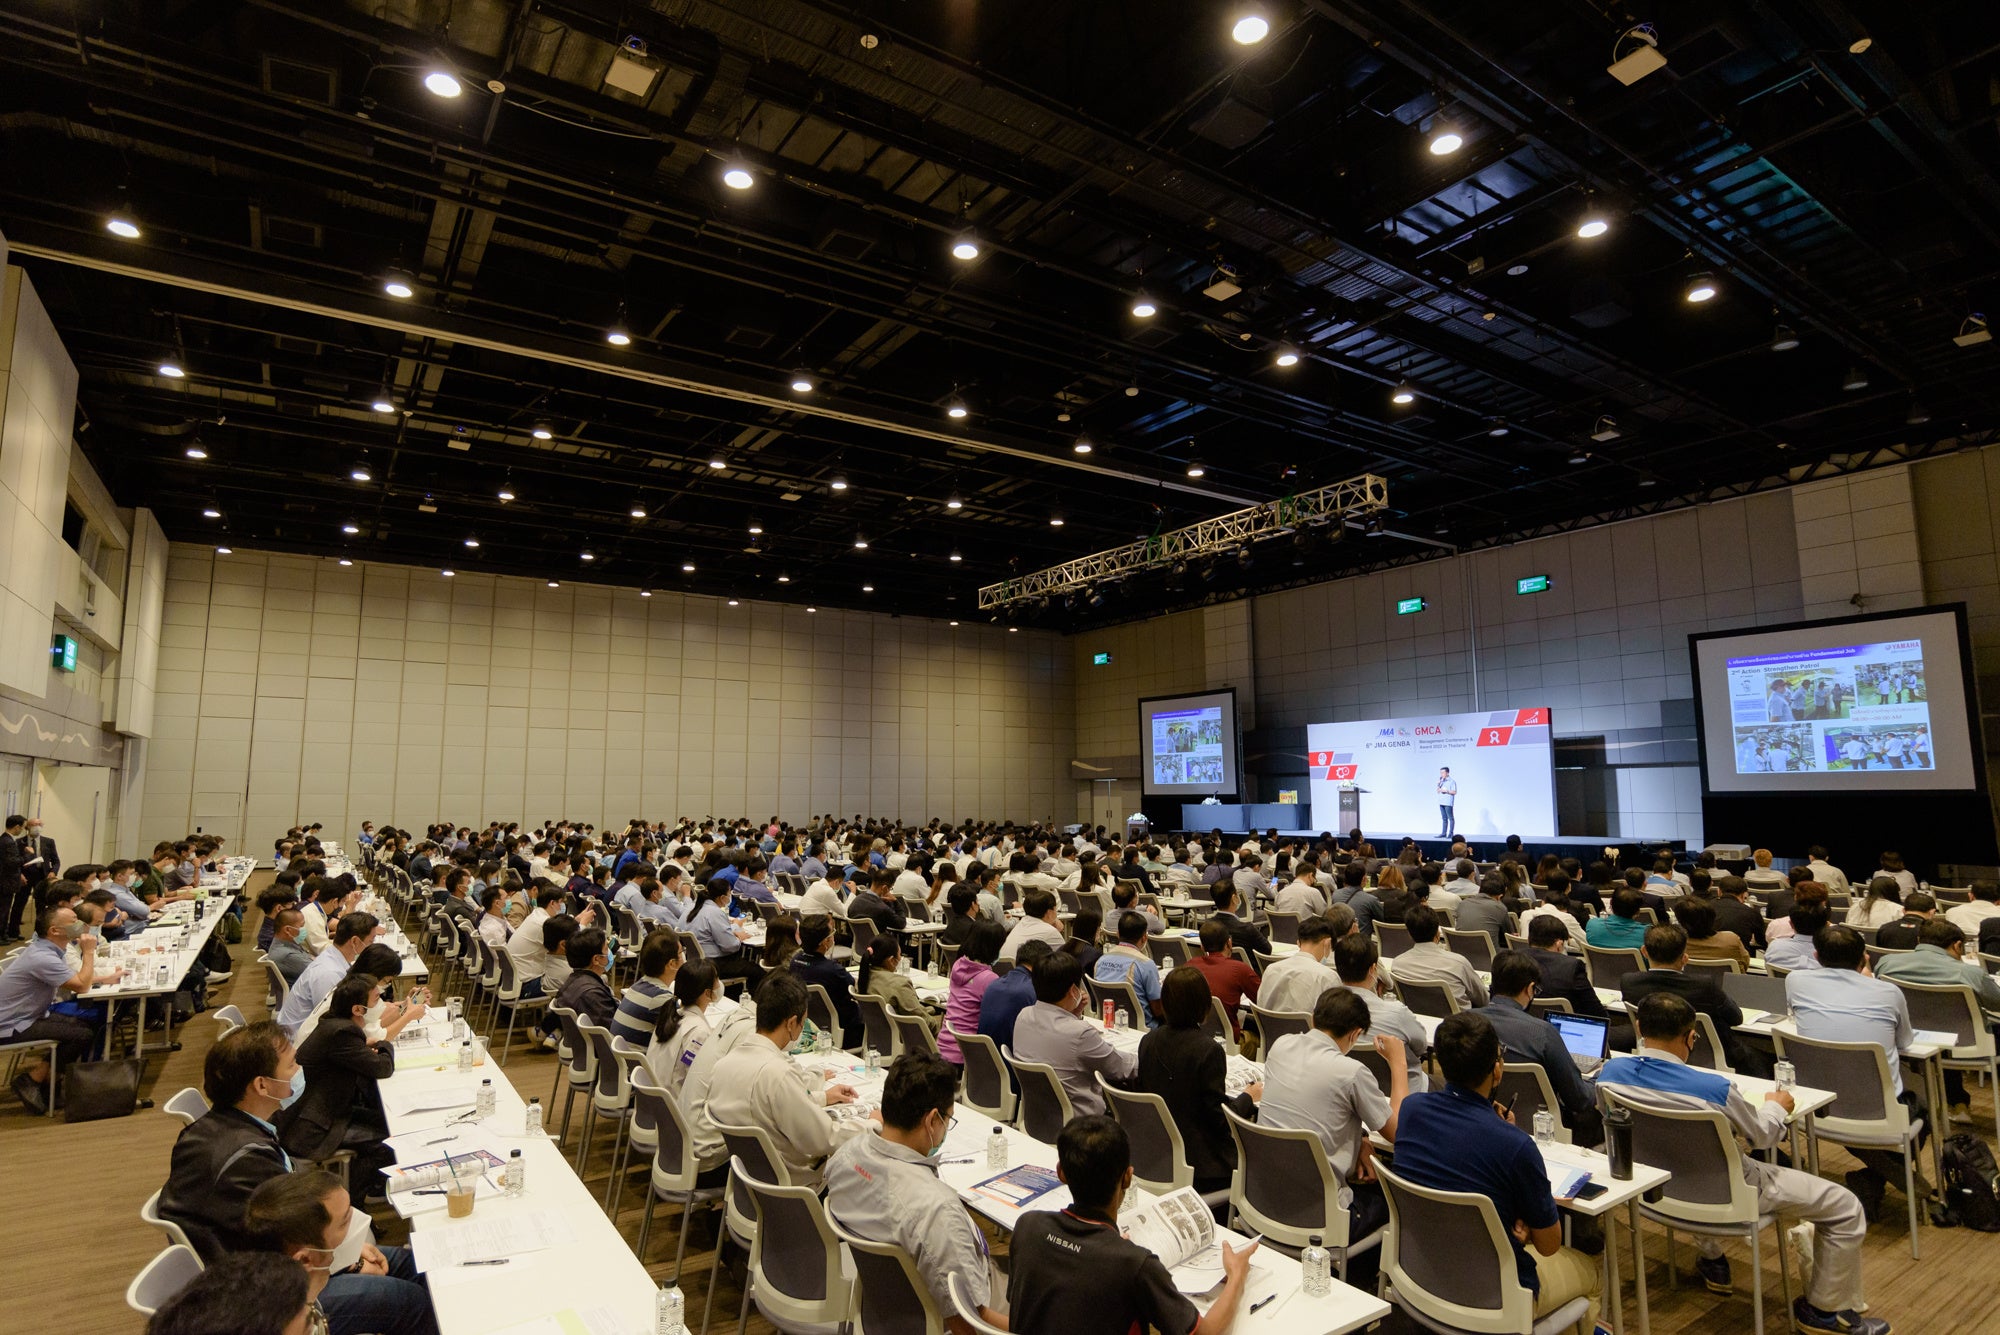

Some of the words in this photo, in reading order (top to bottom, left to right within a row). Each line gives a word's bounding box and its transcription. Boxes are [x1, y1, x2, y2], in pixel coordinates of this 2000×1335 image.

[1763, 665, 1798, 673] Strengthen
[1415, 726, 1441, 736] GMCA
[1388, 740, 1411, 748] GENBA
[1046, 1233, 1081, 1253] NISSAN
